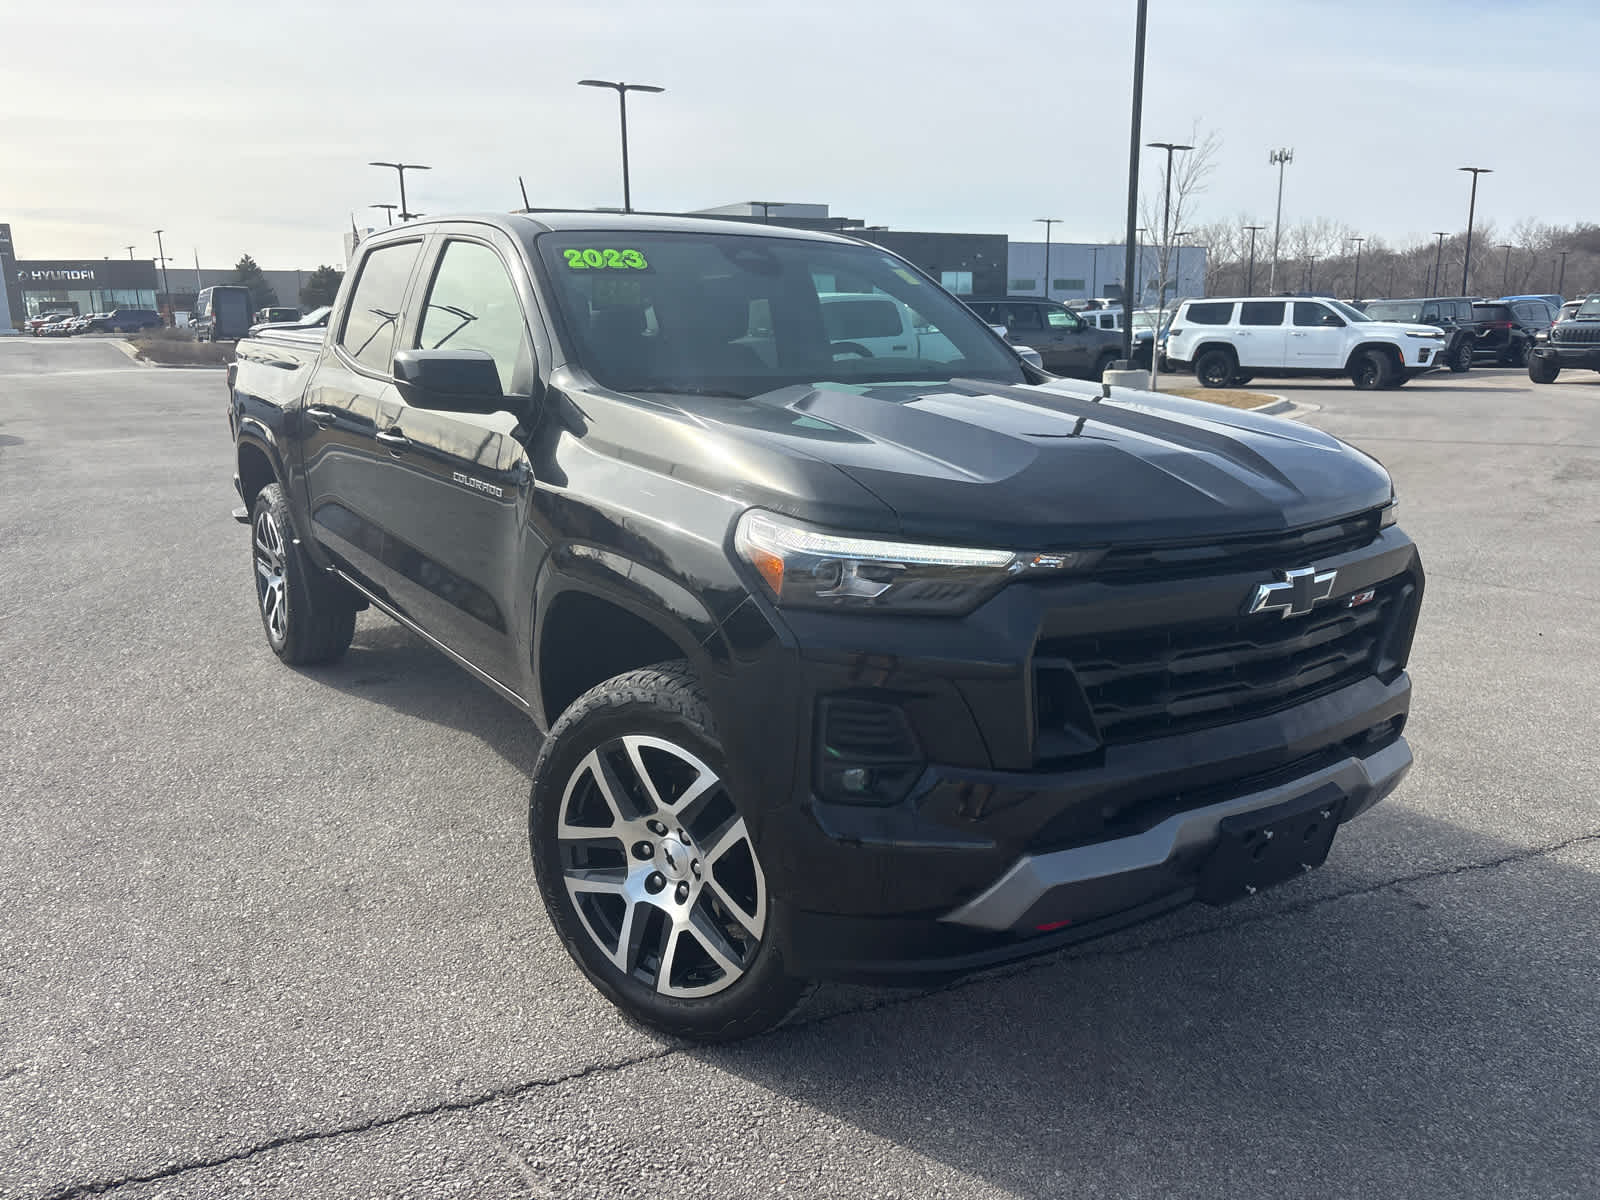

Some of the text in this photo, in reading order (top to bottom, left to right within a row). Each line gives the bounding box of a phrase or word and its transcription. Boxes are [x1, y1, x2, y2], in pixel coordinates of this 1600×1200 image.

[563, 248, 648, 270] 2023
[31, 270, 95, 280] HYUNDAI
[453, 472, 503, 497] COLORADO
